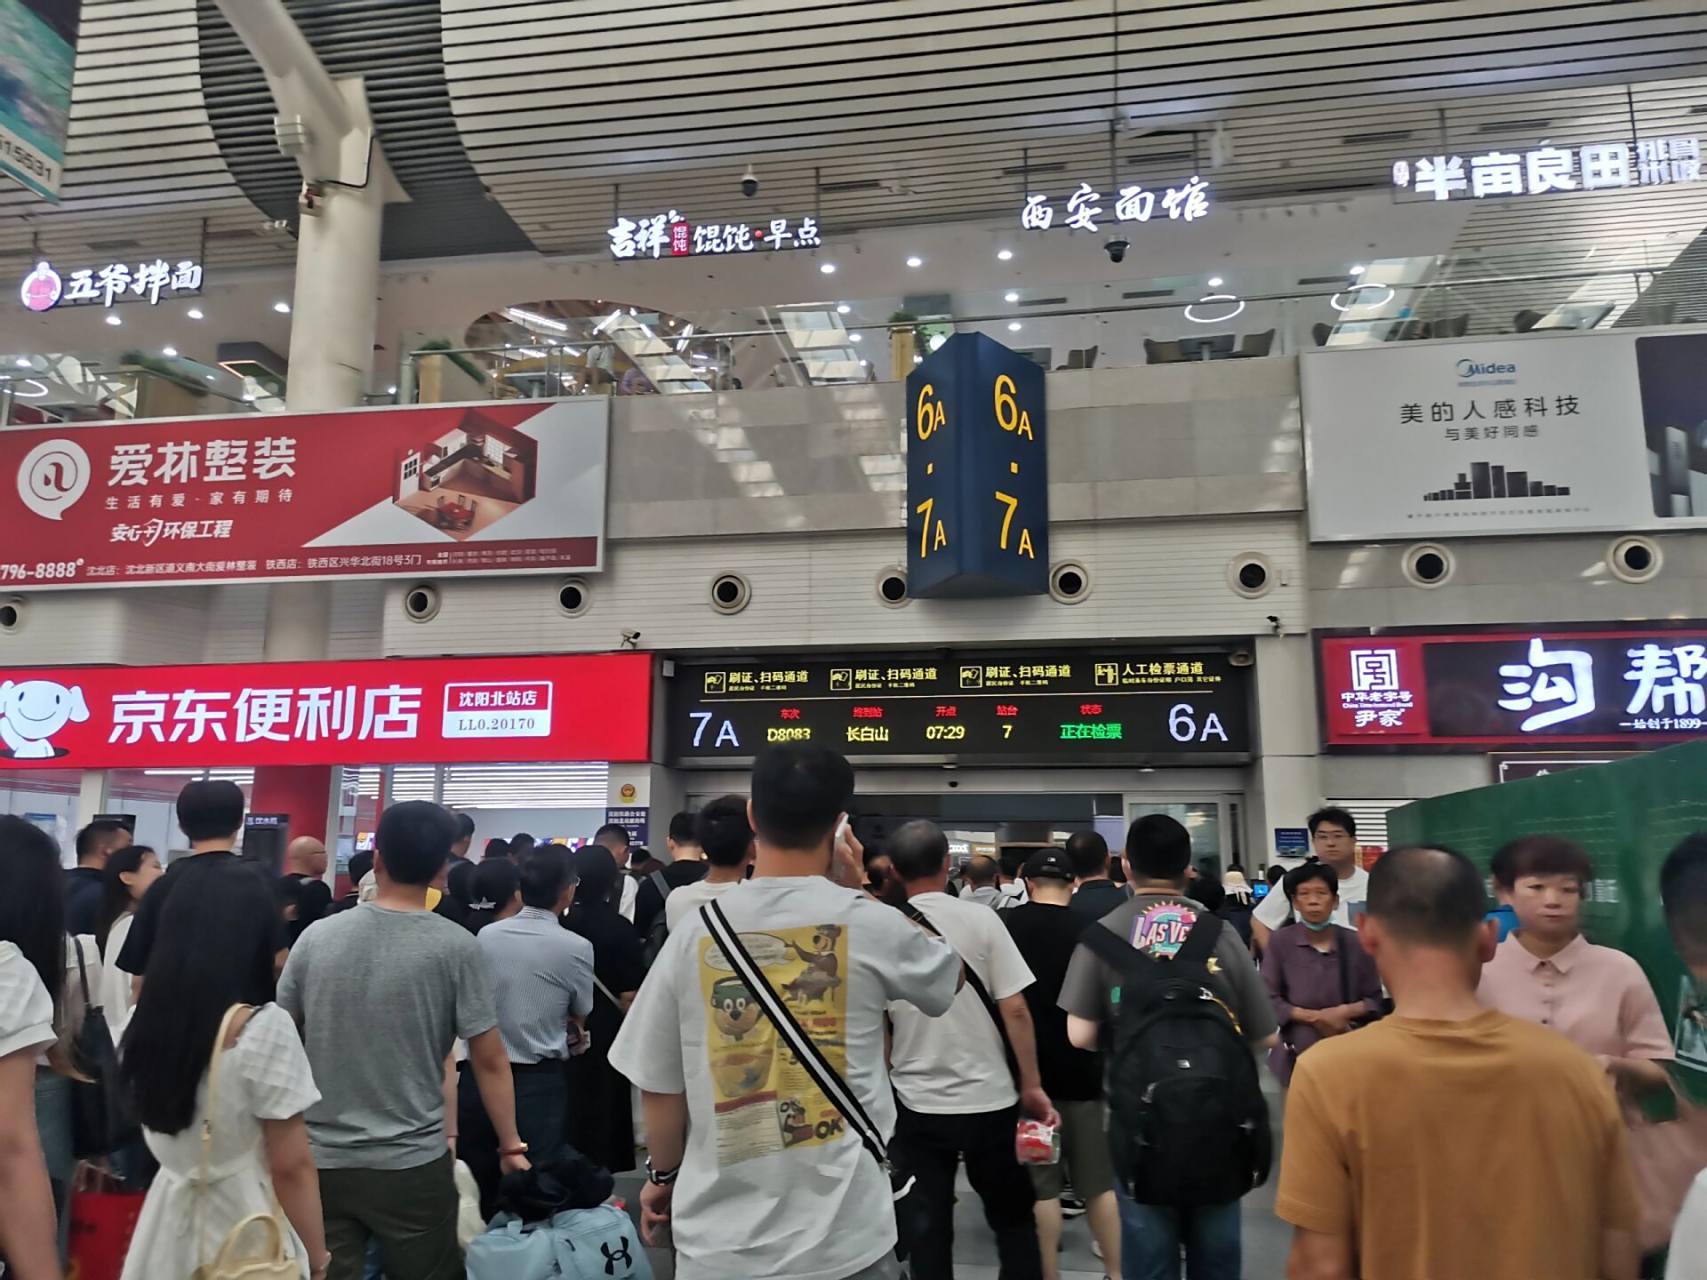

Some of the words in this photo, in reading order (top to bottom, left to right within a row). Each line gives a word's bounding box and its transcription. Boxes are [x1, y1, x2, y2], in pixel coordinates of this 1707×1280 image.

[1414, 143, 1631, 200] 半亩良田
[1021, 175, 1210, 232] 西安面馆
[64, 259, 203, 307] 五爷拌面
[1457, 359, 1516, 378] Midea
[917, 384, 946, 441] 6A
[994, 374, 1034, 441] 6A
[1400, 395, 1581, 425] 美的人感科技
[1445, 424, 1540, 441] 与美好同感
[107, 436, 297, 487] 爱林整装
[916, 497, 947, 559] 7A
[995, 490, 1036, 560] 7A
[1122, 661, 1204, 675] 人工检票通道
[108, 685, 423, 743] 京东便利店
[458, 690, 537, 708] 沈阳北站店
[689, 712, 740, 747] 7A
[846, 726, 889, 742] 长白山
[926, 726, 965, 740] 07:29
[1002, 724, 1013, 739] 7
[1060, 723, 1123, 740] 正在检票
[1168, 703, 1229, 742] 6A
